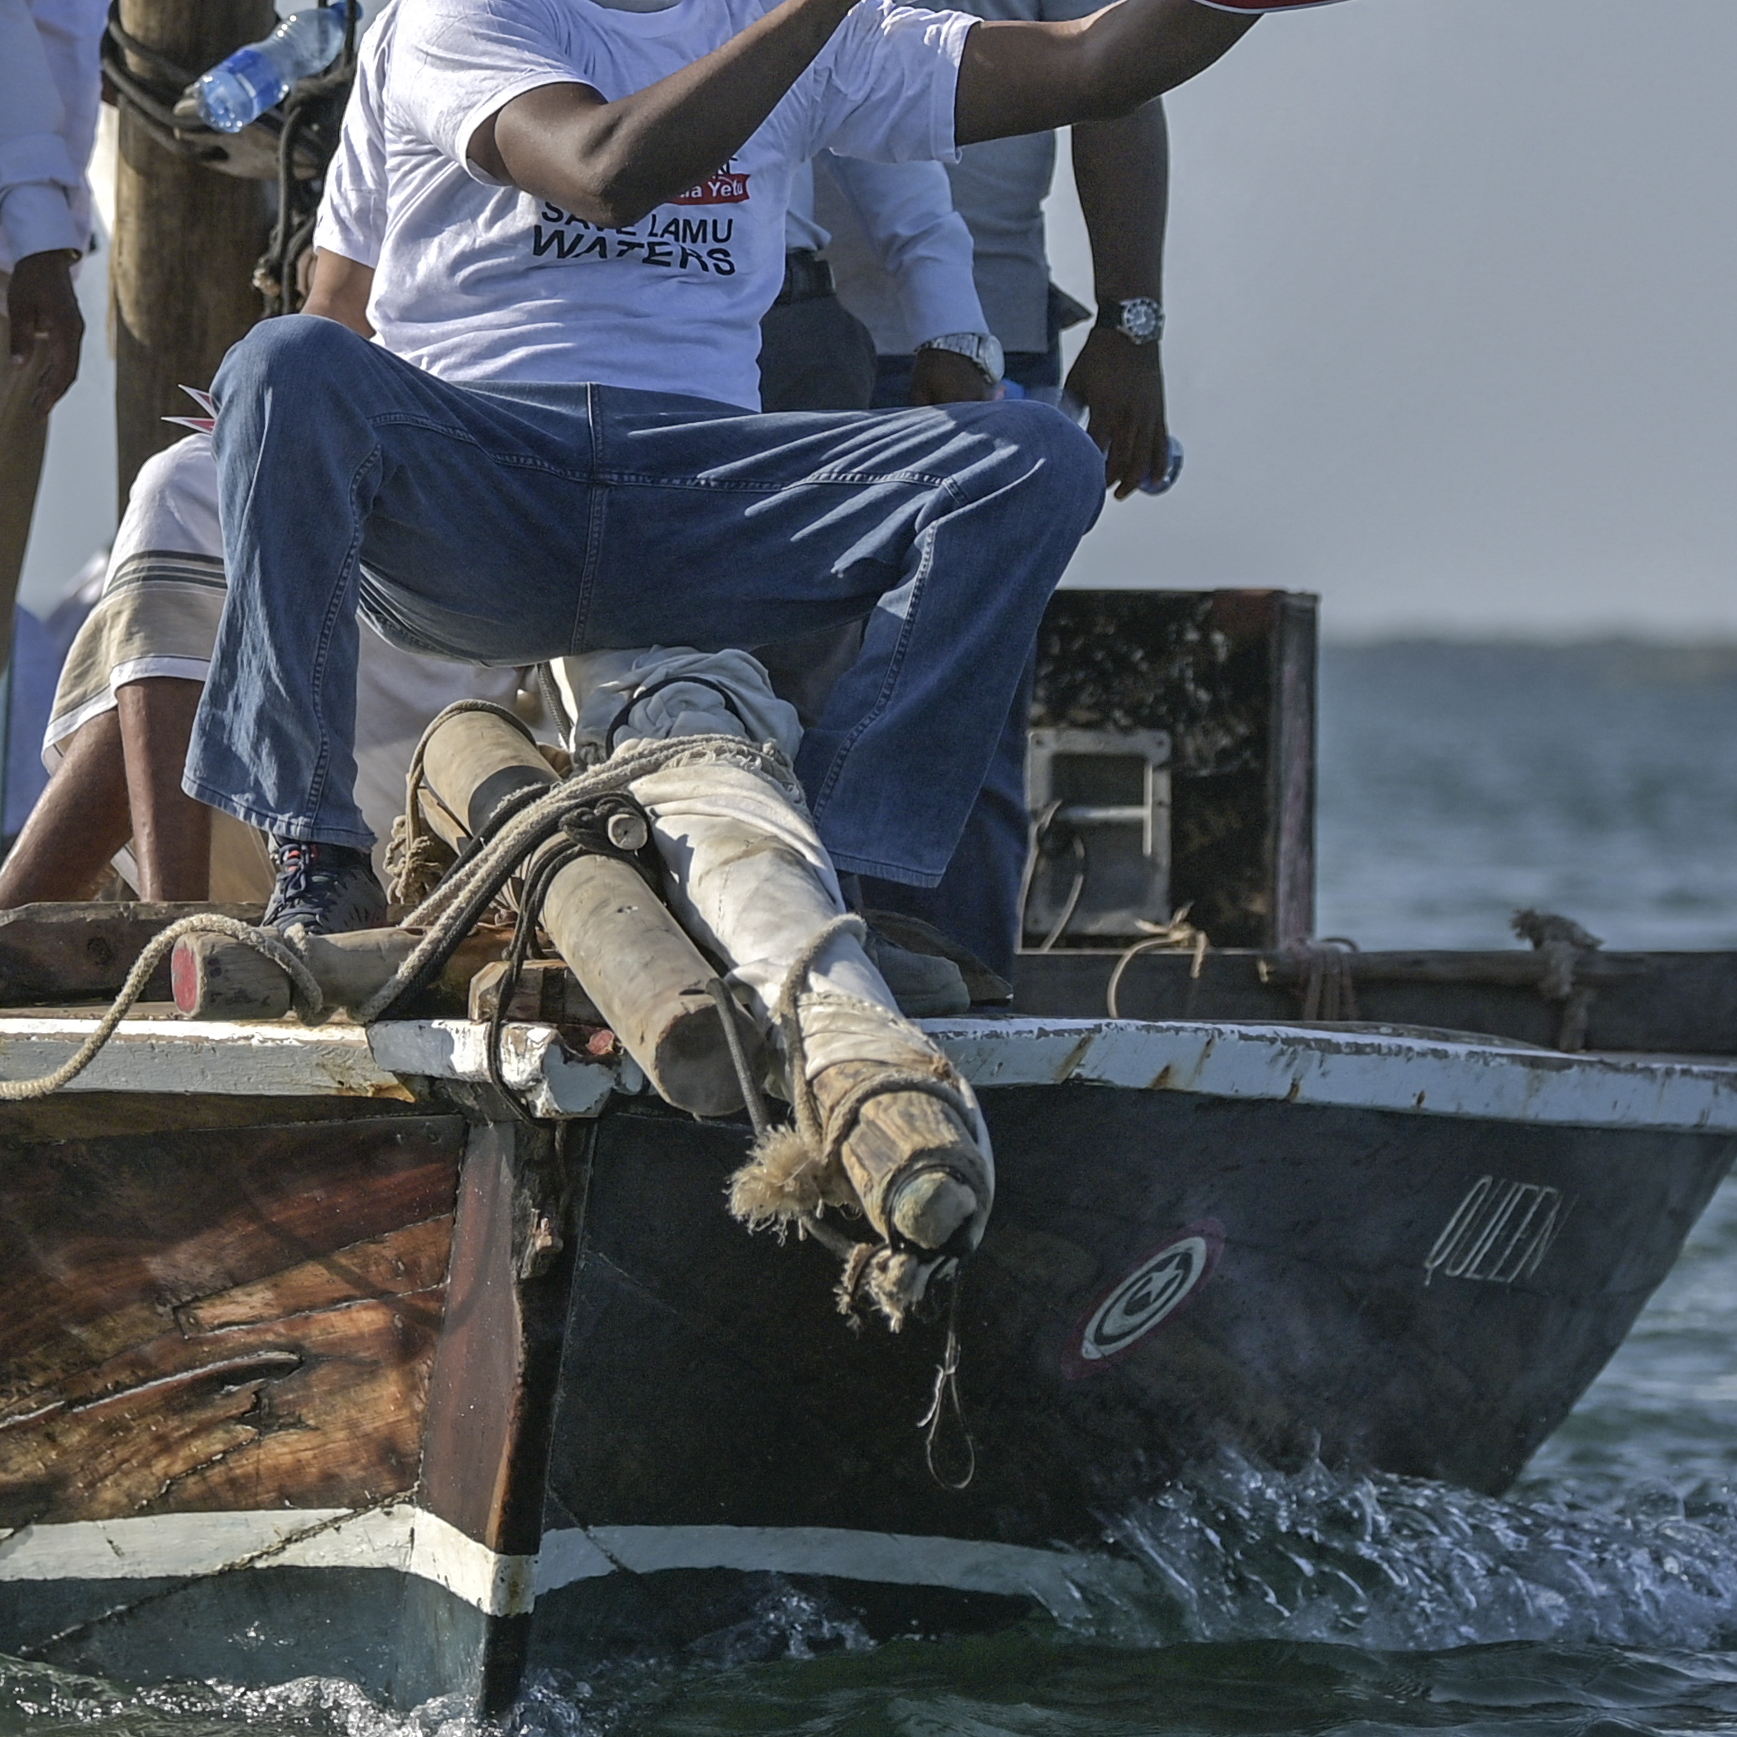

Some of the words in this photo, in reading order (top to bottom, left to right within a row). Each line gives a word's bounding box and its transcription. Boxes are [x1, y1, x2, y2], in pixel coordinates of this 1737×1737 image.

[533, 225, 736, 276] WATERS
[647, 213, 734, 245] LAMU
[1423, 1174, 1581, 1287] QUEEN
